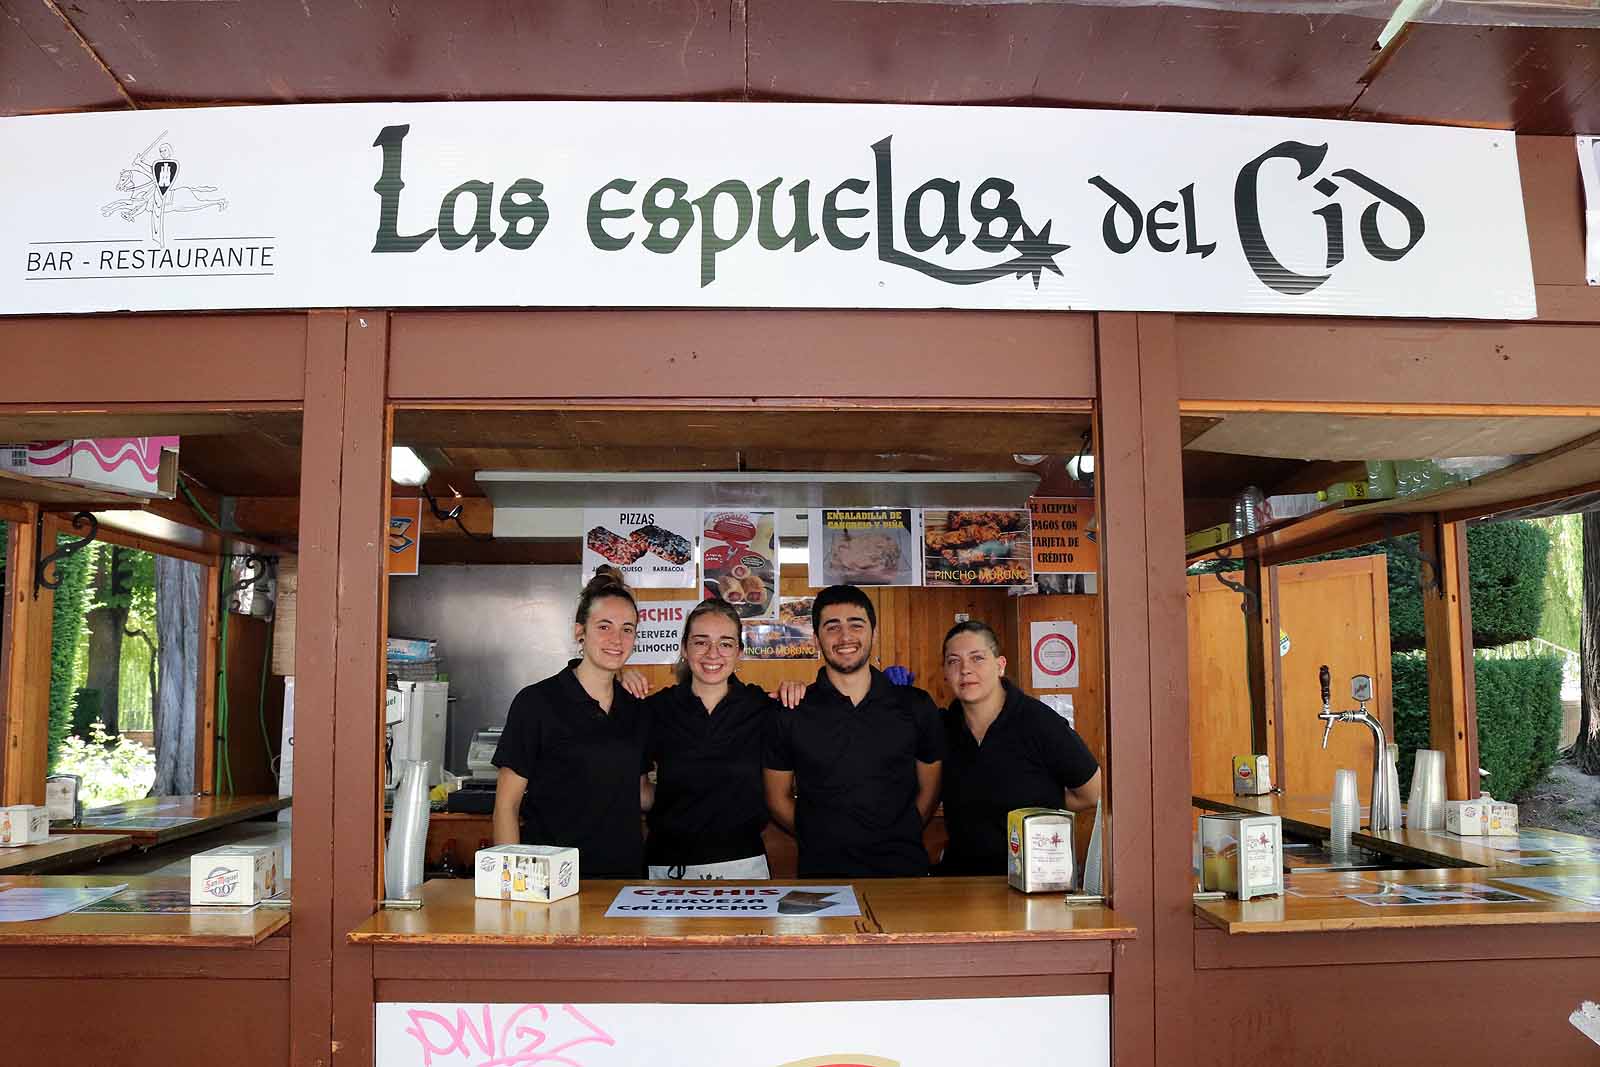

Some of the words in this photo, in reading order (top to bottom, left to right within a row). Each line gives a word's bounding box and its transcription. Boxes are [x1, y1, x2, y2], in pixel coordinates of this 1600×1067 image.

[371, 124, 550, 254] Las
[1087, 174, 1217, 257] del
[1233, 140, 1426, 295] Cid
[26, 251, 73, 271] BAR
[99, 246, 275, 270] RESTAURANTE
[1029, 503, 1041, 513] SE
[1042, 503, 1078, 513] ACEPTAN
[619, 513, 655, 525] PIZZAS
[826, 511, 888, 520] ENSALADILLA
[889, 511, 902, 520] DE
[1032, 520, 1059, 530] PAGOS
[1061, 520, 1078, 530] CON
[1032, 537, 1065, 548] TARJETA
[1068, 537, 1079, 547] DE
[1037, 551, 1074, 563] CRÉDITO
[934, 570, 977, 581] PINCHO
[638, 607, 683, 623] ACHIS
[635, 630, 678, 639] CERVEZA
[632, 643, 680, 653] ALIMOCHO
[744, 646, 774, 655] INCHO
[633, 888, 780, 897] CACHIS
